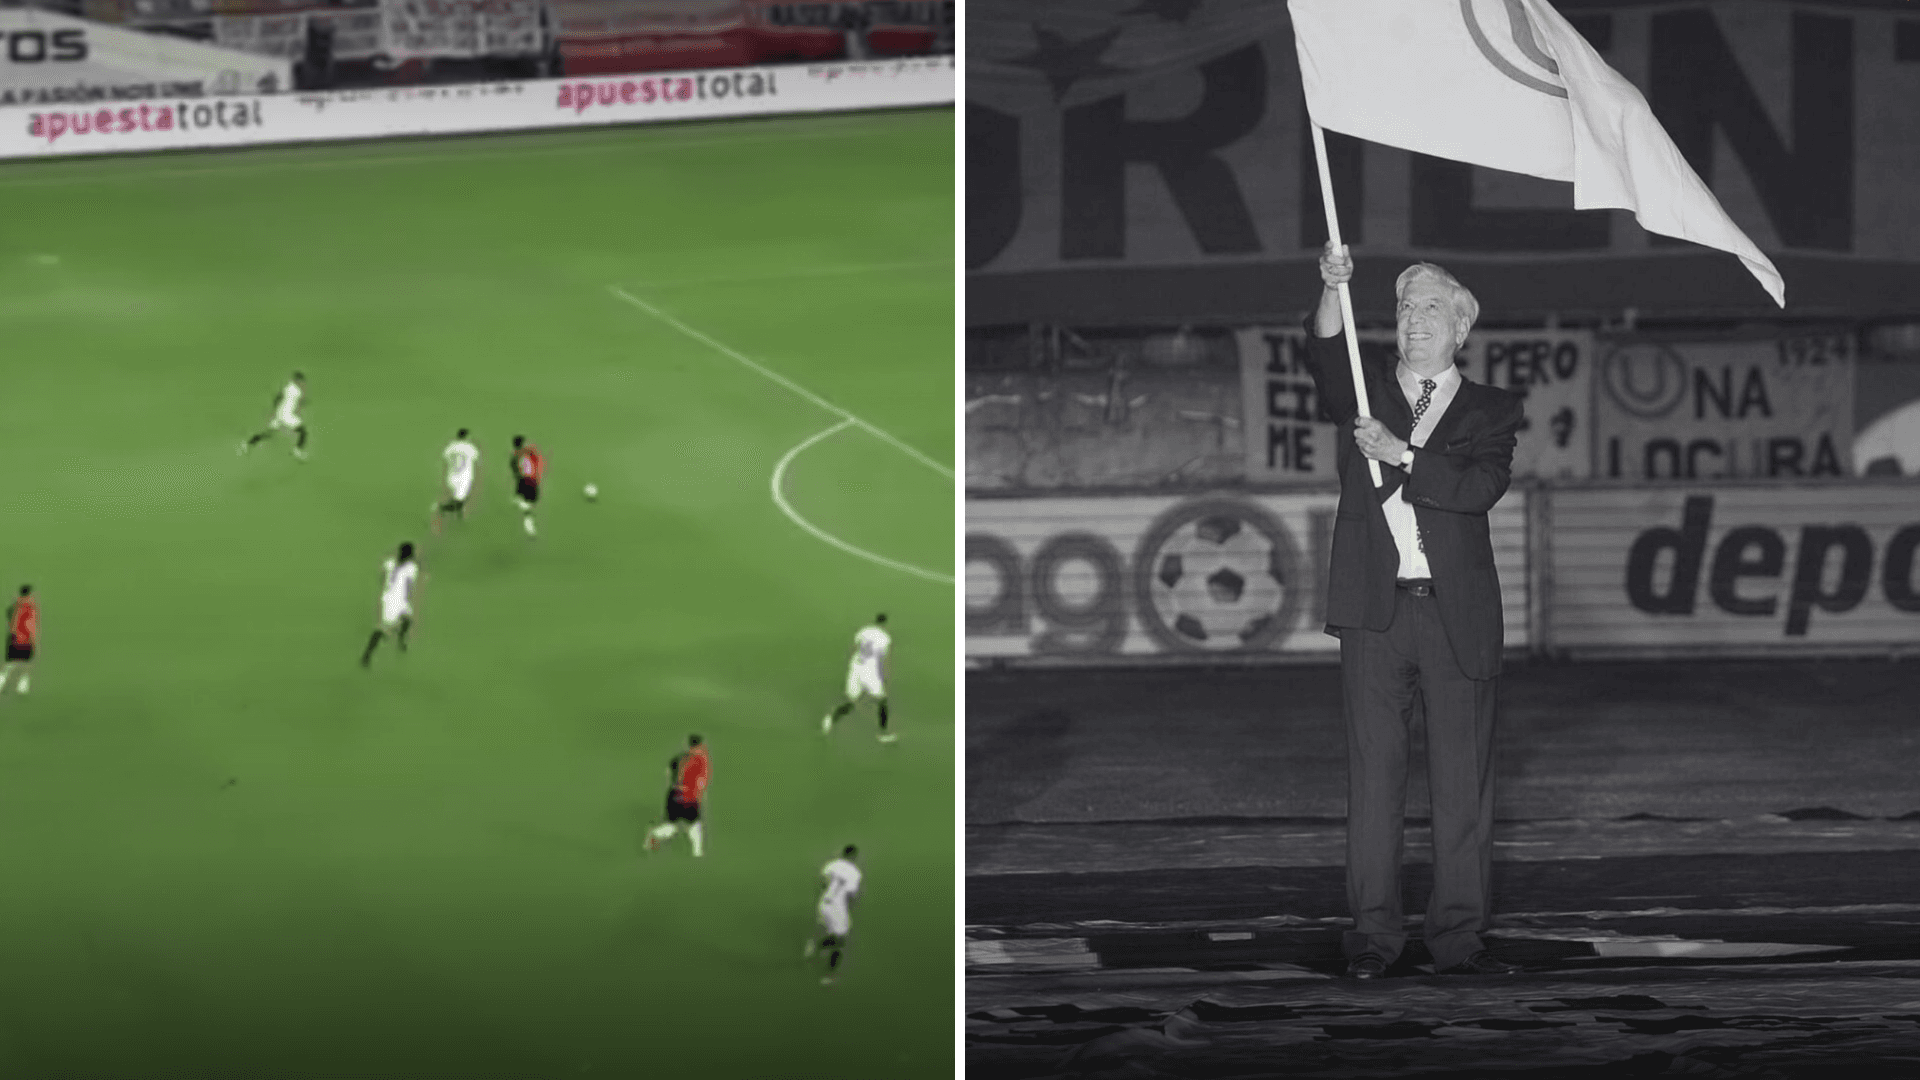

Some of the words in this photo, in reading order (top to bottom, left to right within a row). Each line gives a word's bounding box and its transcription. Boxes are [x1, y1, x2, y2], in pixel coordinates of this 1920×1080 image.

[0, 29, 88, 62] OS
[1486, 340, 1578, 386] PERO
[1268, 424, 1313, 472] ME
